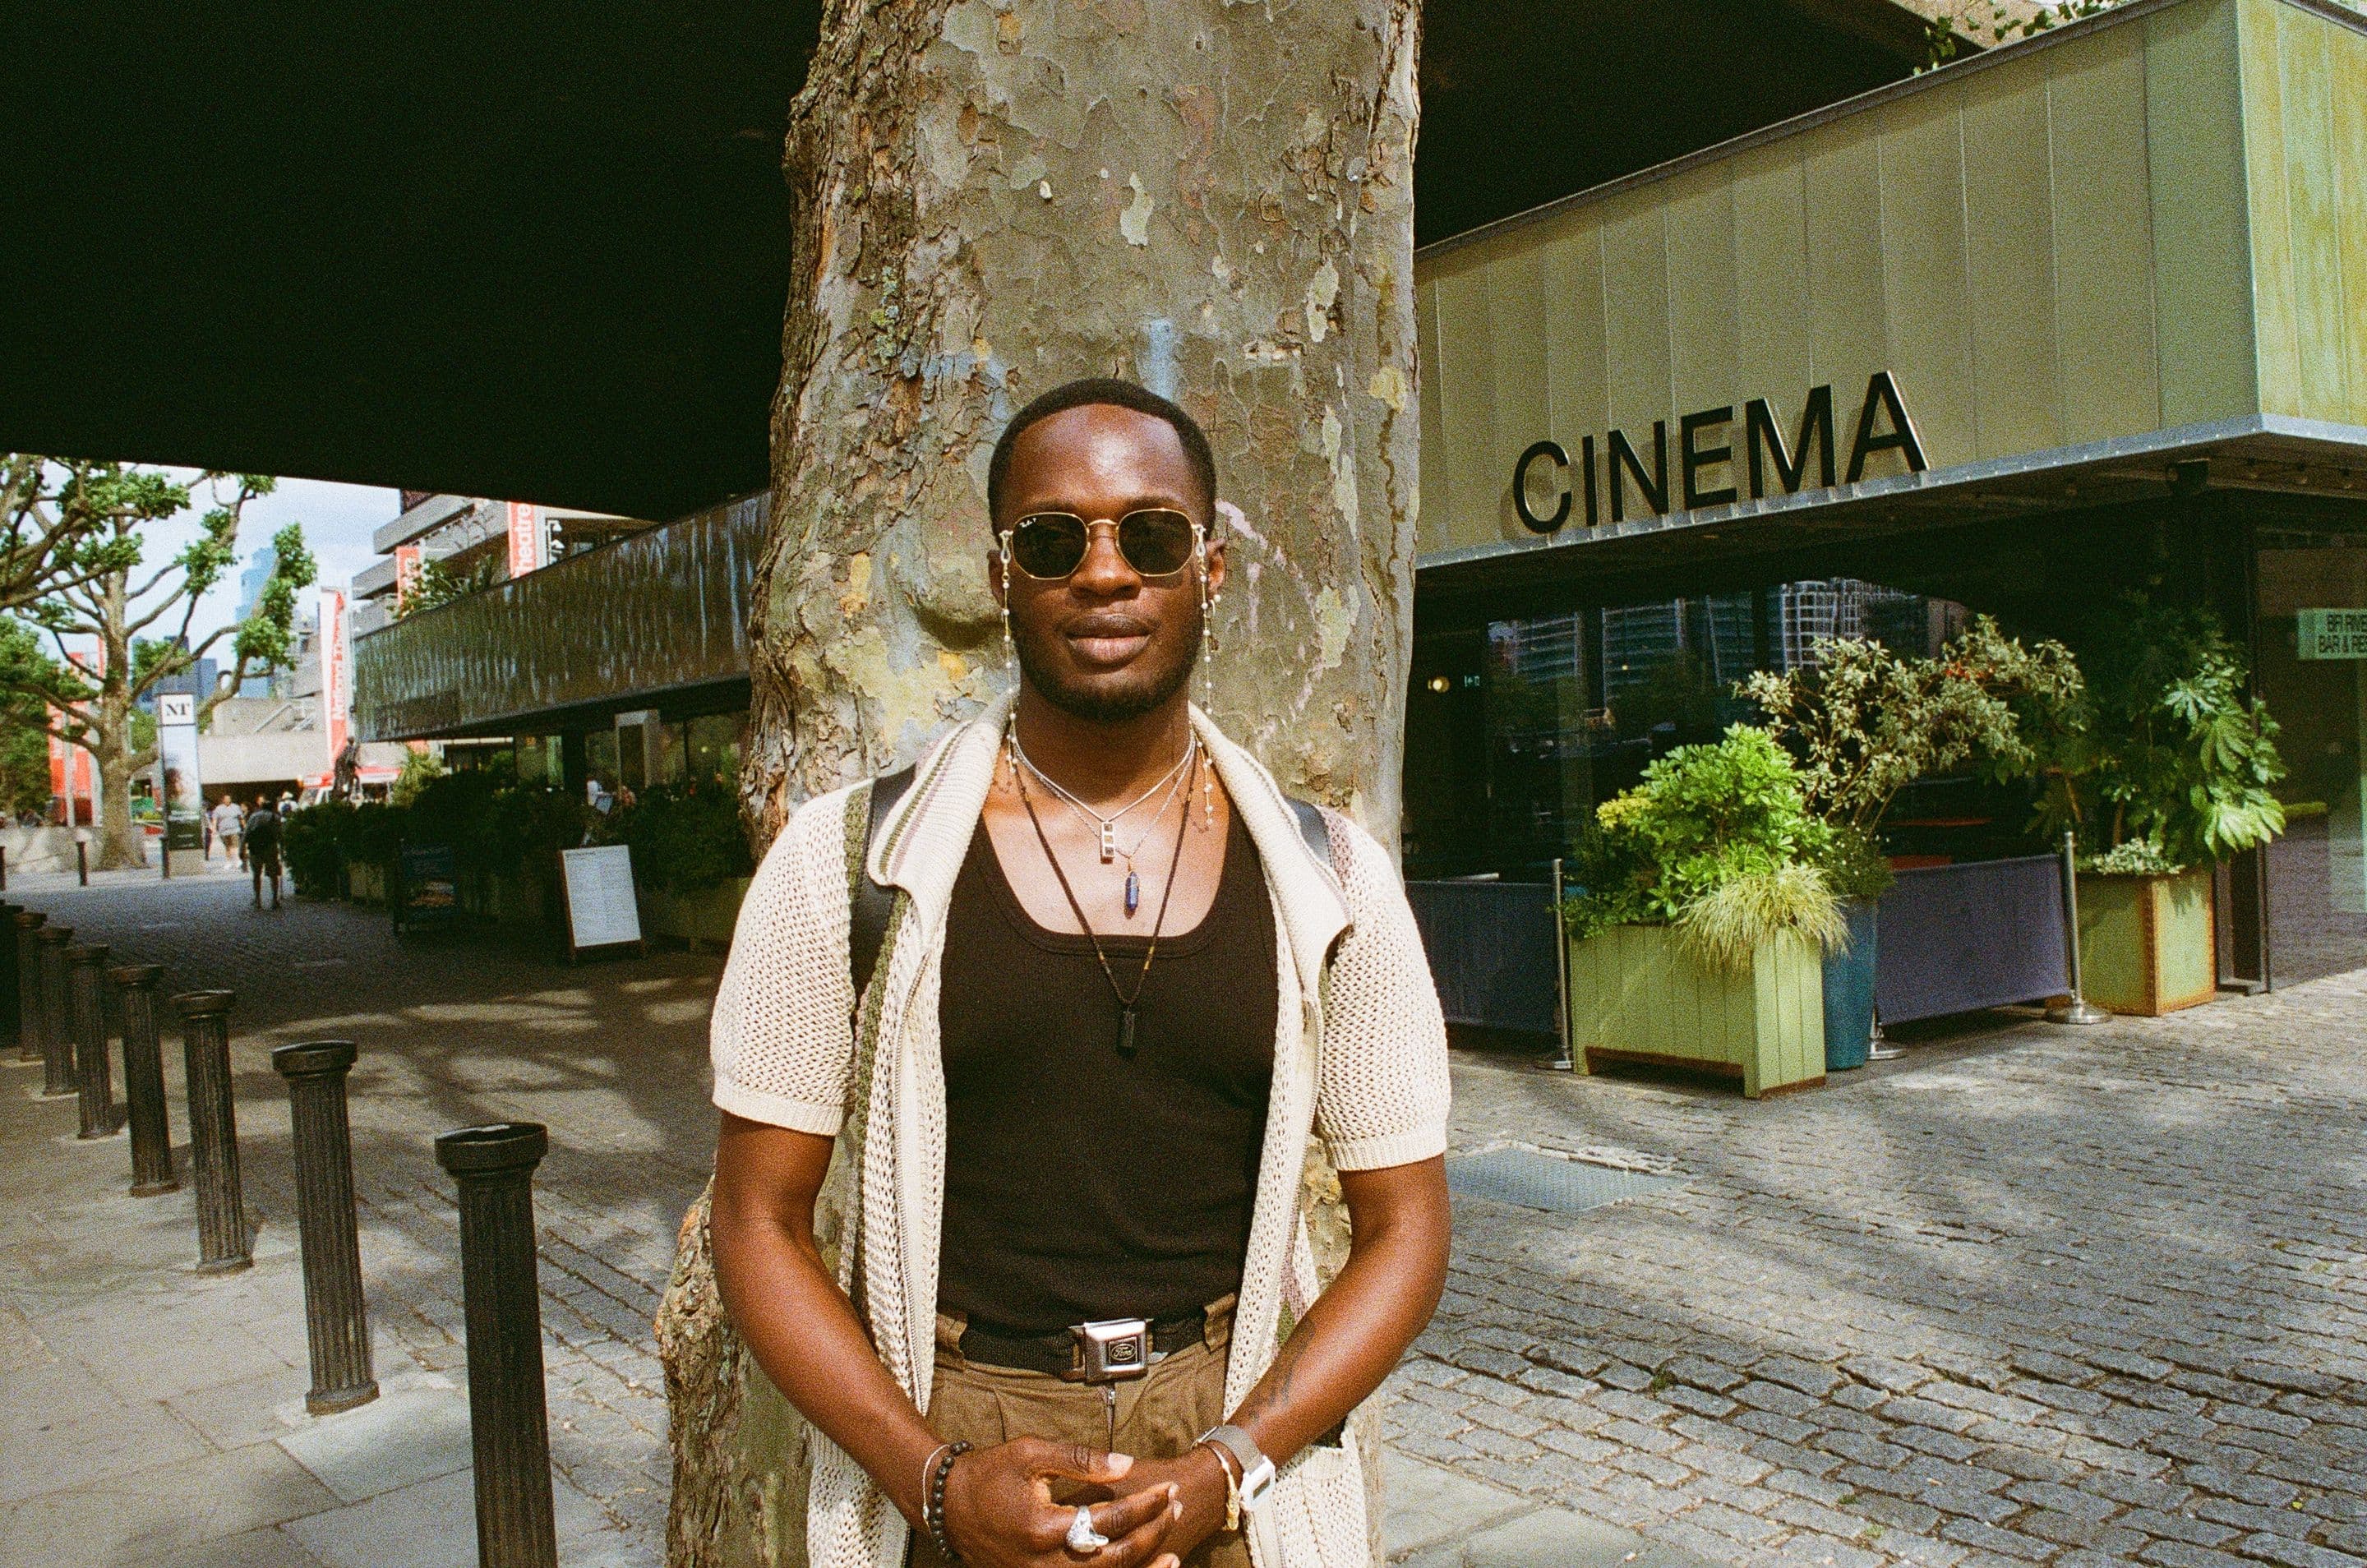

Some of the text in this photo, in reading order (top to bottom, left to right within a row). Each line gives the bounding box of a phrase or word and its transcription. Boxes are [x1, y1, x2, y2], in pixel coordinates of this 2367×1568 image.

[1513, 371, 1930, 534] CINEMA
[2319, 635, 2340, 653] BAR
[165, 703, 190, 716] NT
